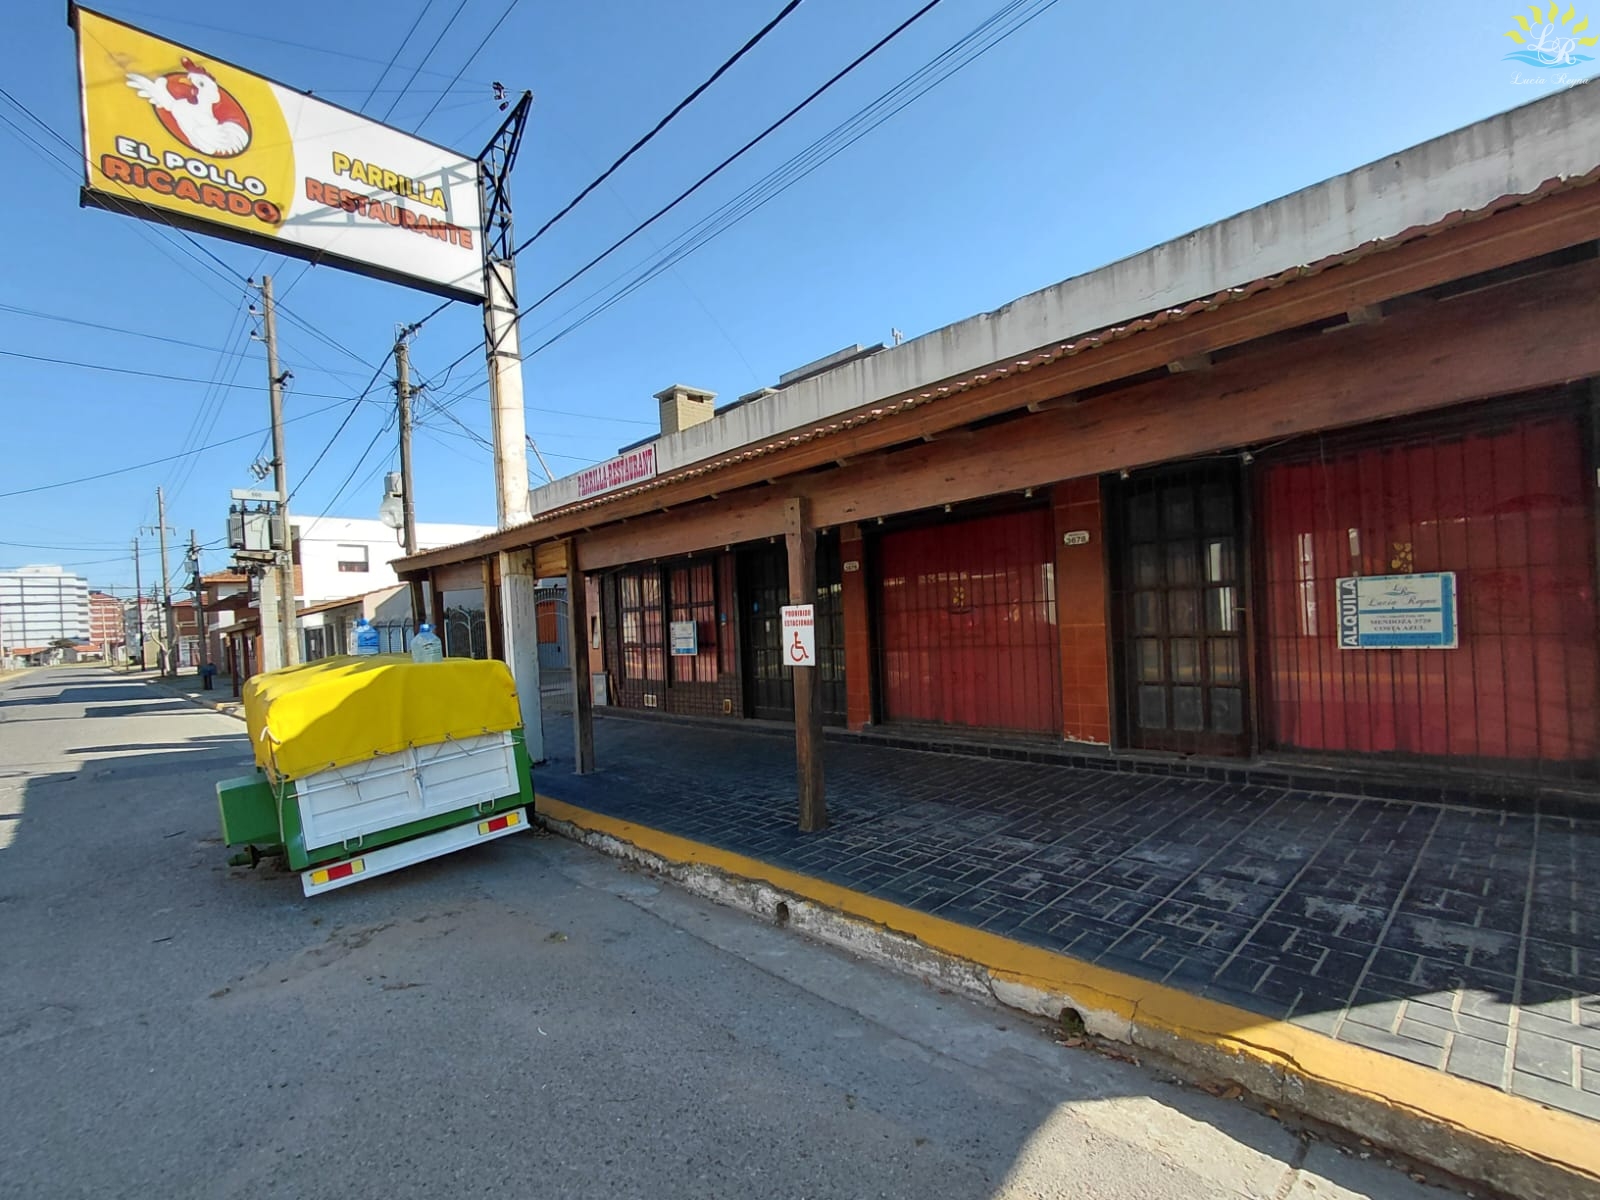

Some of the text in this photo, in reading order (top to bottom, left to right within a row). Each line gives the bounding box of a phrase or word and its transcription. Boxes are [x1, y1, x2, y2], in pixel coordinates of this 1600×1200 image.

[101, 153, 280, 225] RICARDO
[115, 136, 266, 196] EL POLLO
[332, 151, 447, 211] PARRILLA
[305, 177, 474, 250] RESTAURANTE
[1342, 579, 1358, 645] ALQUILA
